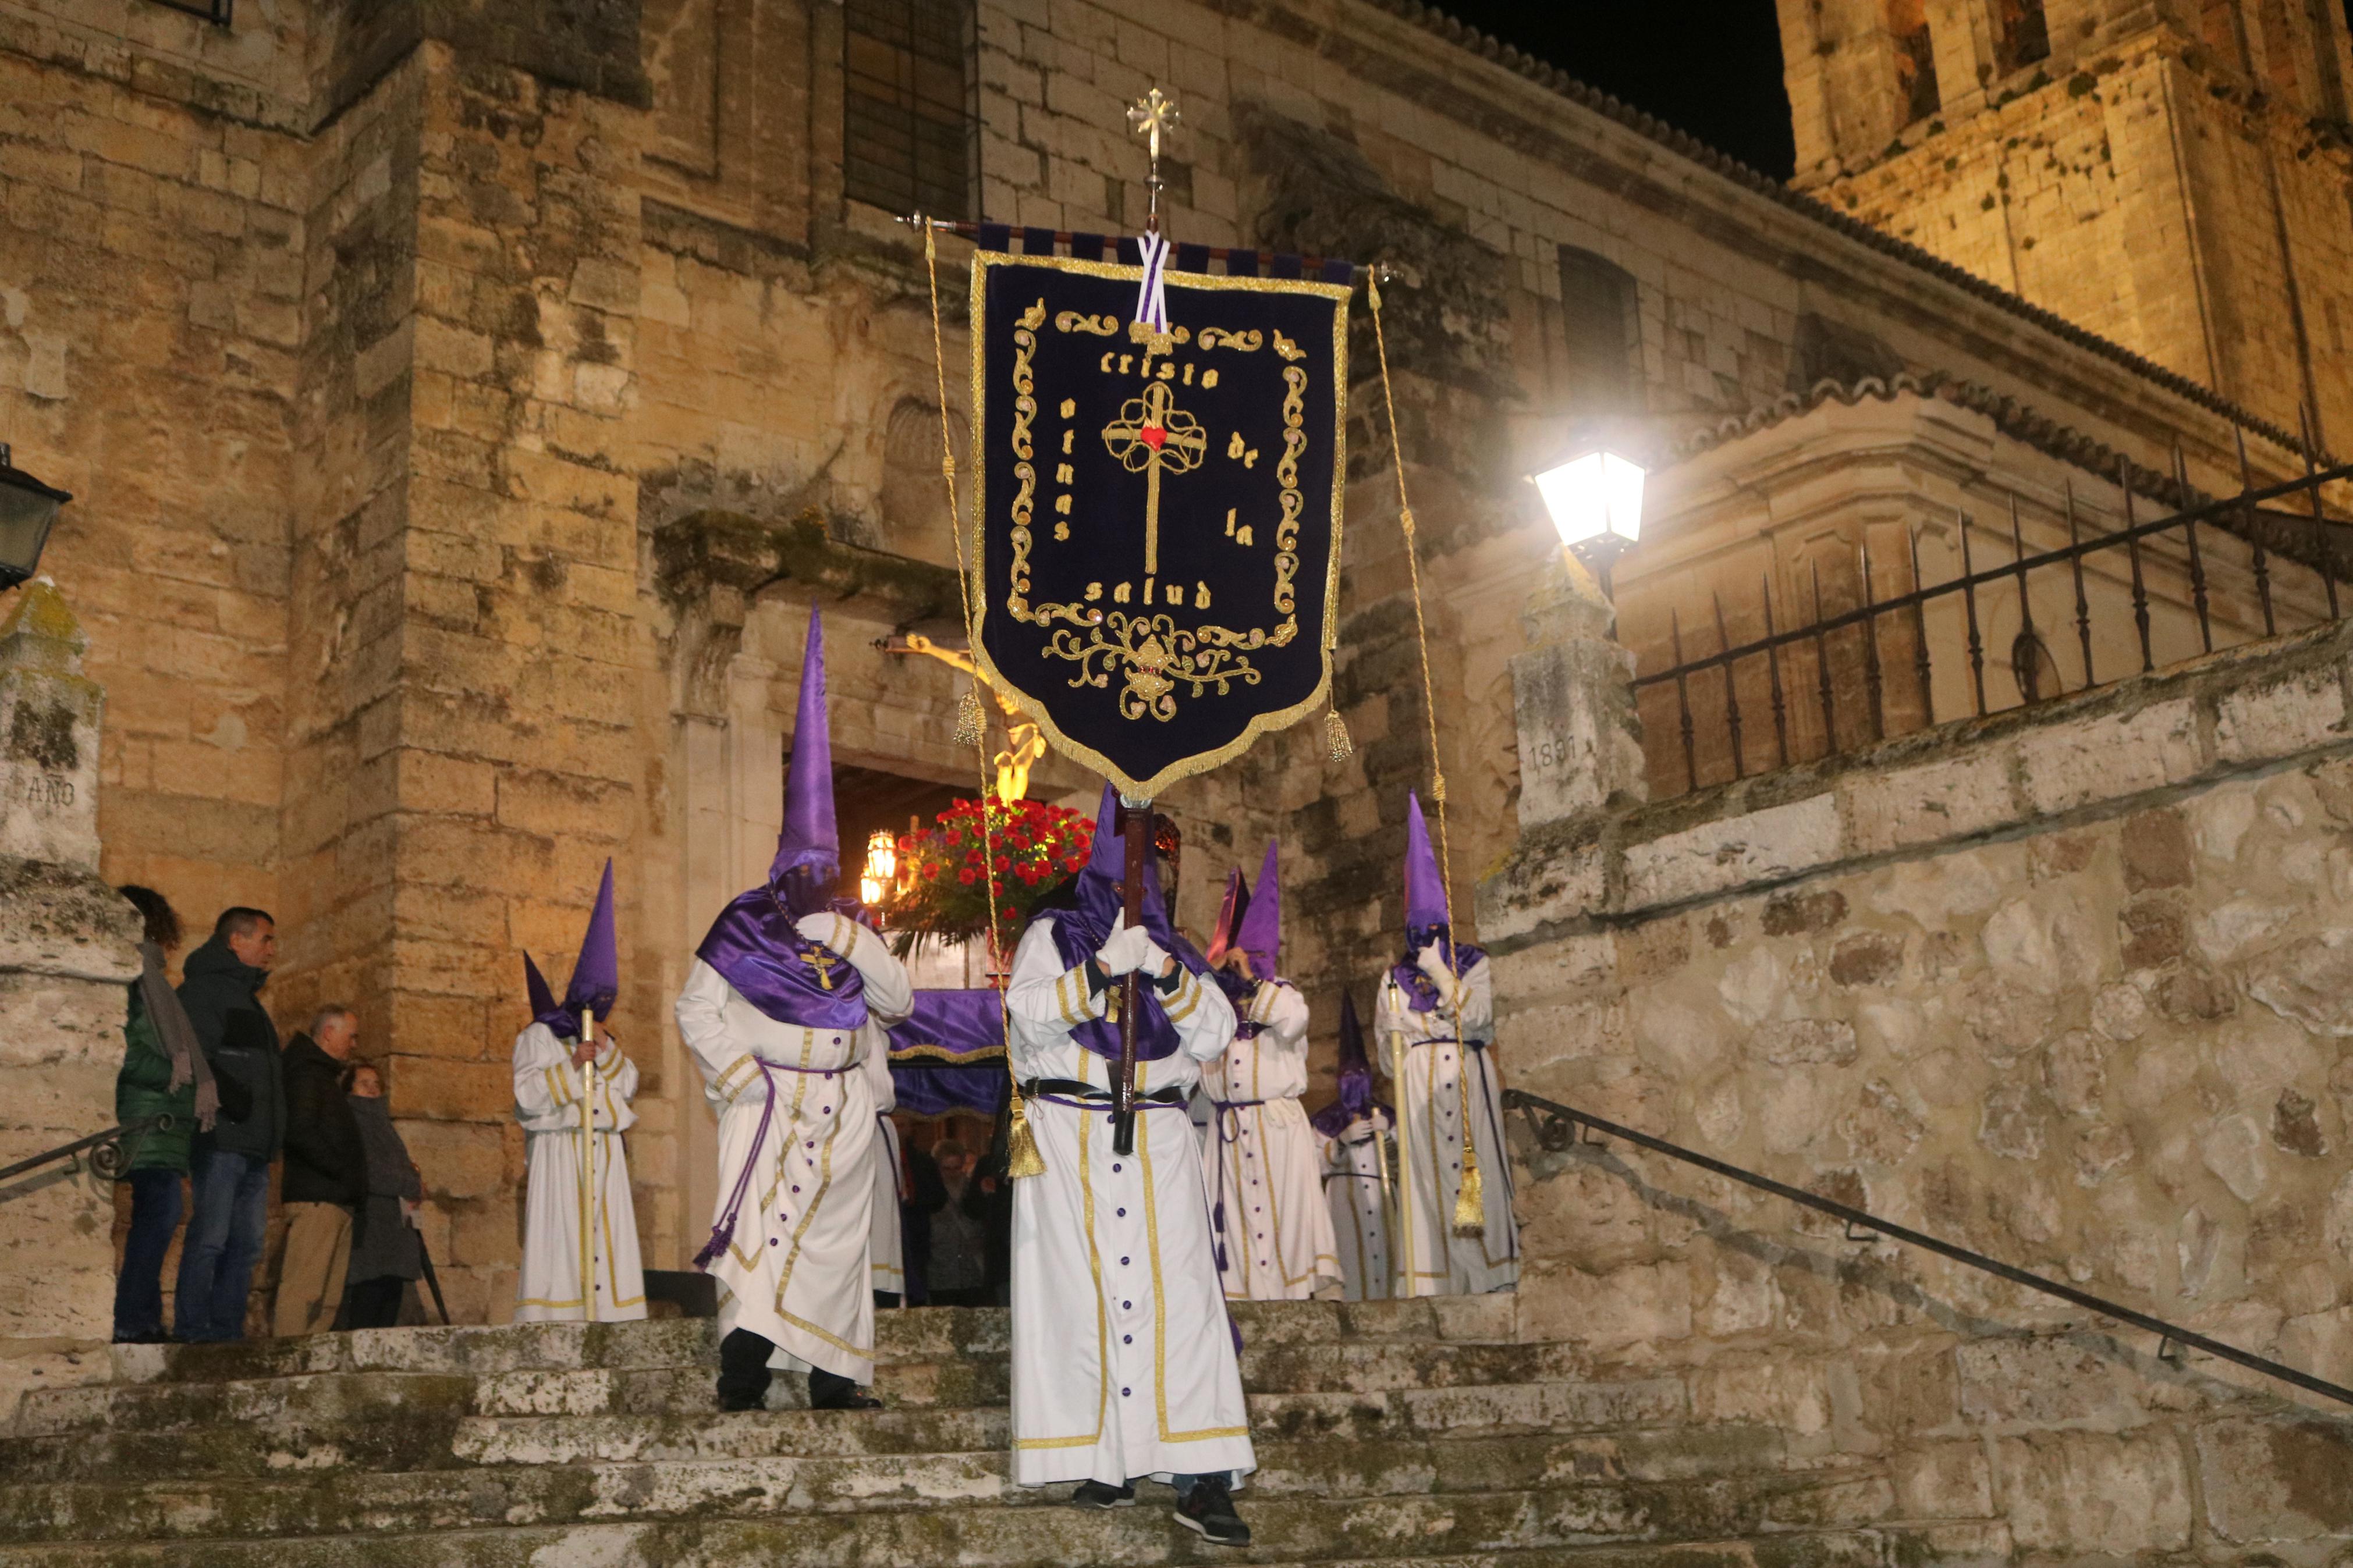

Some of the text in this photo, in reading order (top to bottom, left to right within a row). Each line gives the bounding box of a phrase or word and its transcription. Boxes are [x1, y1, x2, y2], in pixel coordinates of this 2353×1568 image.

[1101, 352, 1219, 389] cristo
[1227, 432, 1258, 469] de
[1225, 508, 1253, 546] la
[1084, 577, 1211, 609] salud
[27, 774, 74, 807] AÑO
